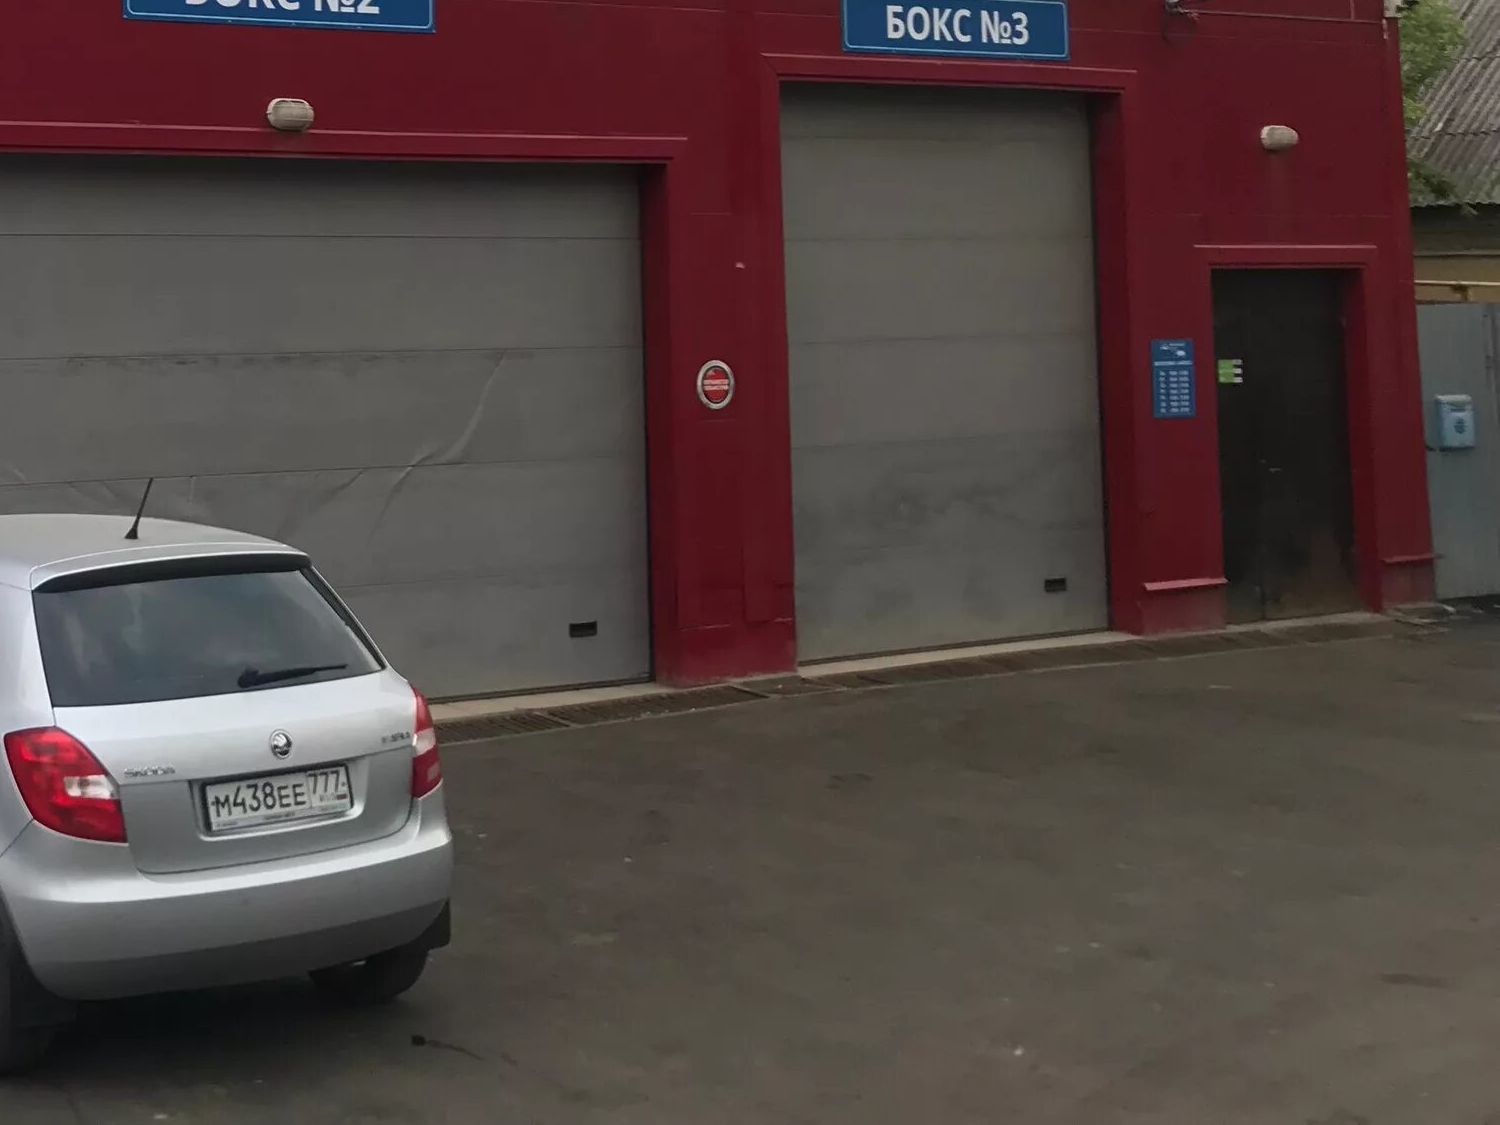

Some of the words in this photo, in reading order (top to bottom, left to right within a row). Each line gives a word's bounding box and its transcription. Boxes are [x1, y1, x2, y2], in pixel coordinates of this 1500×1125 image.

[886, 5, 972, 43] БОКС
[980, 10, 1029, 45] №3
[308, 770, 341, 794] 777
